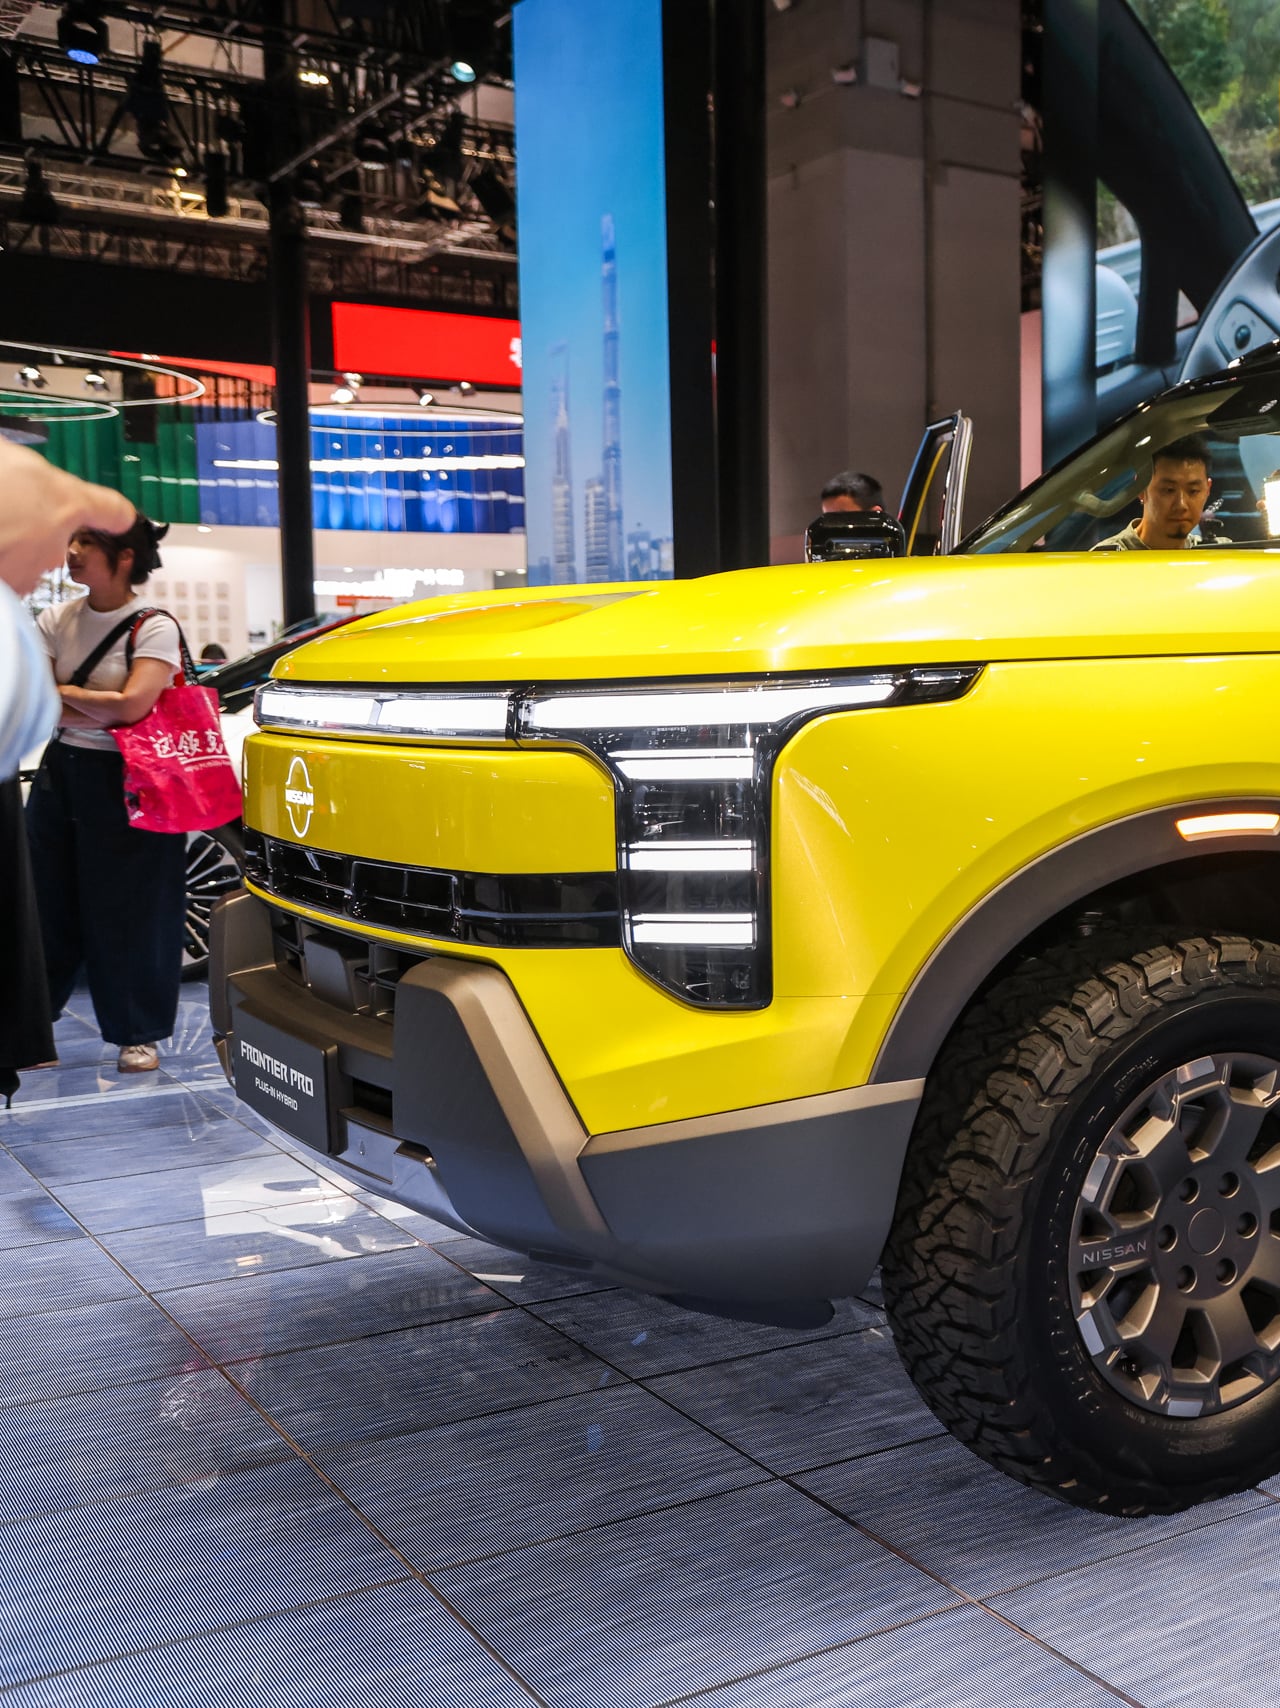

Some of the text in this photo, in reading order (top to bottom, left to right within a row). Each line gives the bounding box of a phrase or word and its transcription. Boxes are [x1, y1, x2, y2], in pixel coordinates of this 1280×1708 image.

[240, 1039, 314, 1097] FRONTIER PRO
[255, 1076, 298, 1111] PLUG-IN HYBRID
[1083, 1240, 1147, 1264] NISSAN
